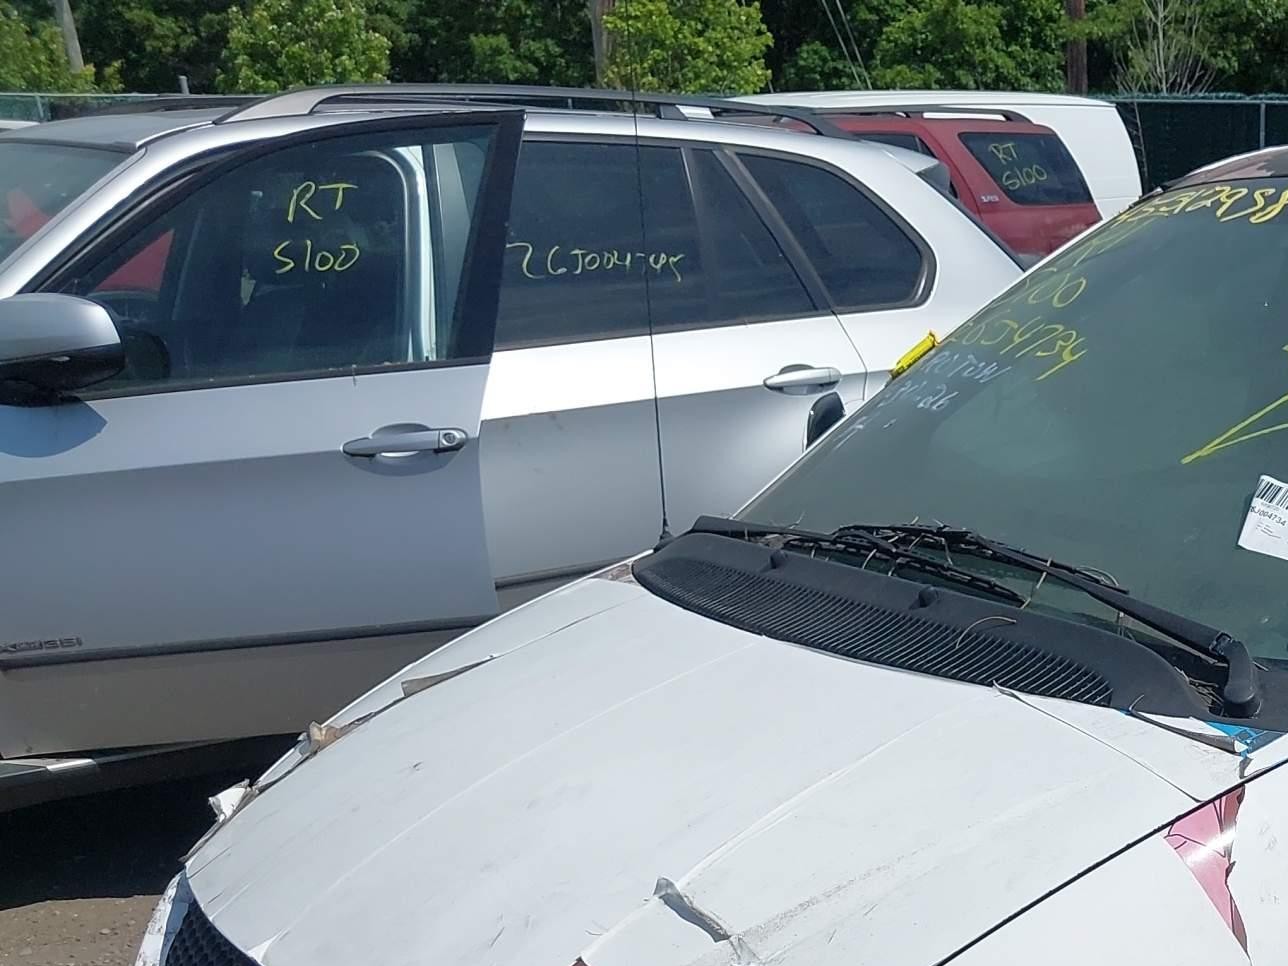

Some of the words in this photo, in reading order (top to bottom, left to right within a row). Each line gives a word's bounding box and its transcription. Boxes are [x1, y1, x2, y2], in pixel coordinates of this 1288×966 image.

[988, 143, 1018, 166] RT
[1002, 164, 1048, 190] S100
[287, 181, 359, 223] RT
[273, 240, 360, 274] S100
